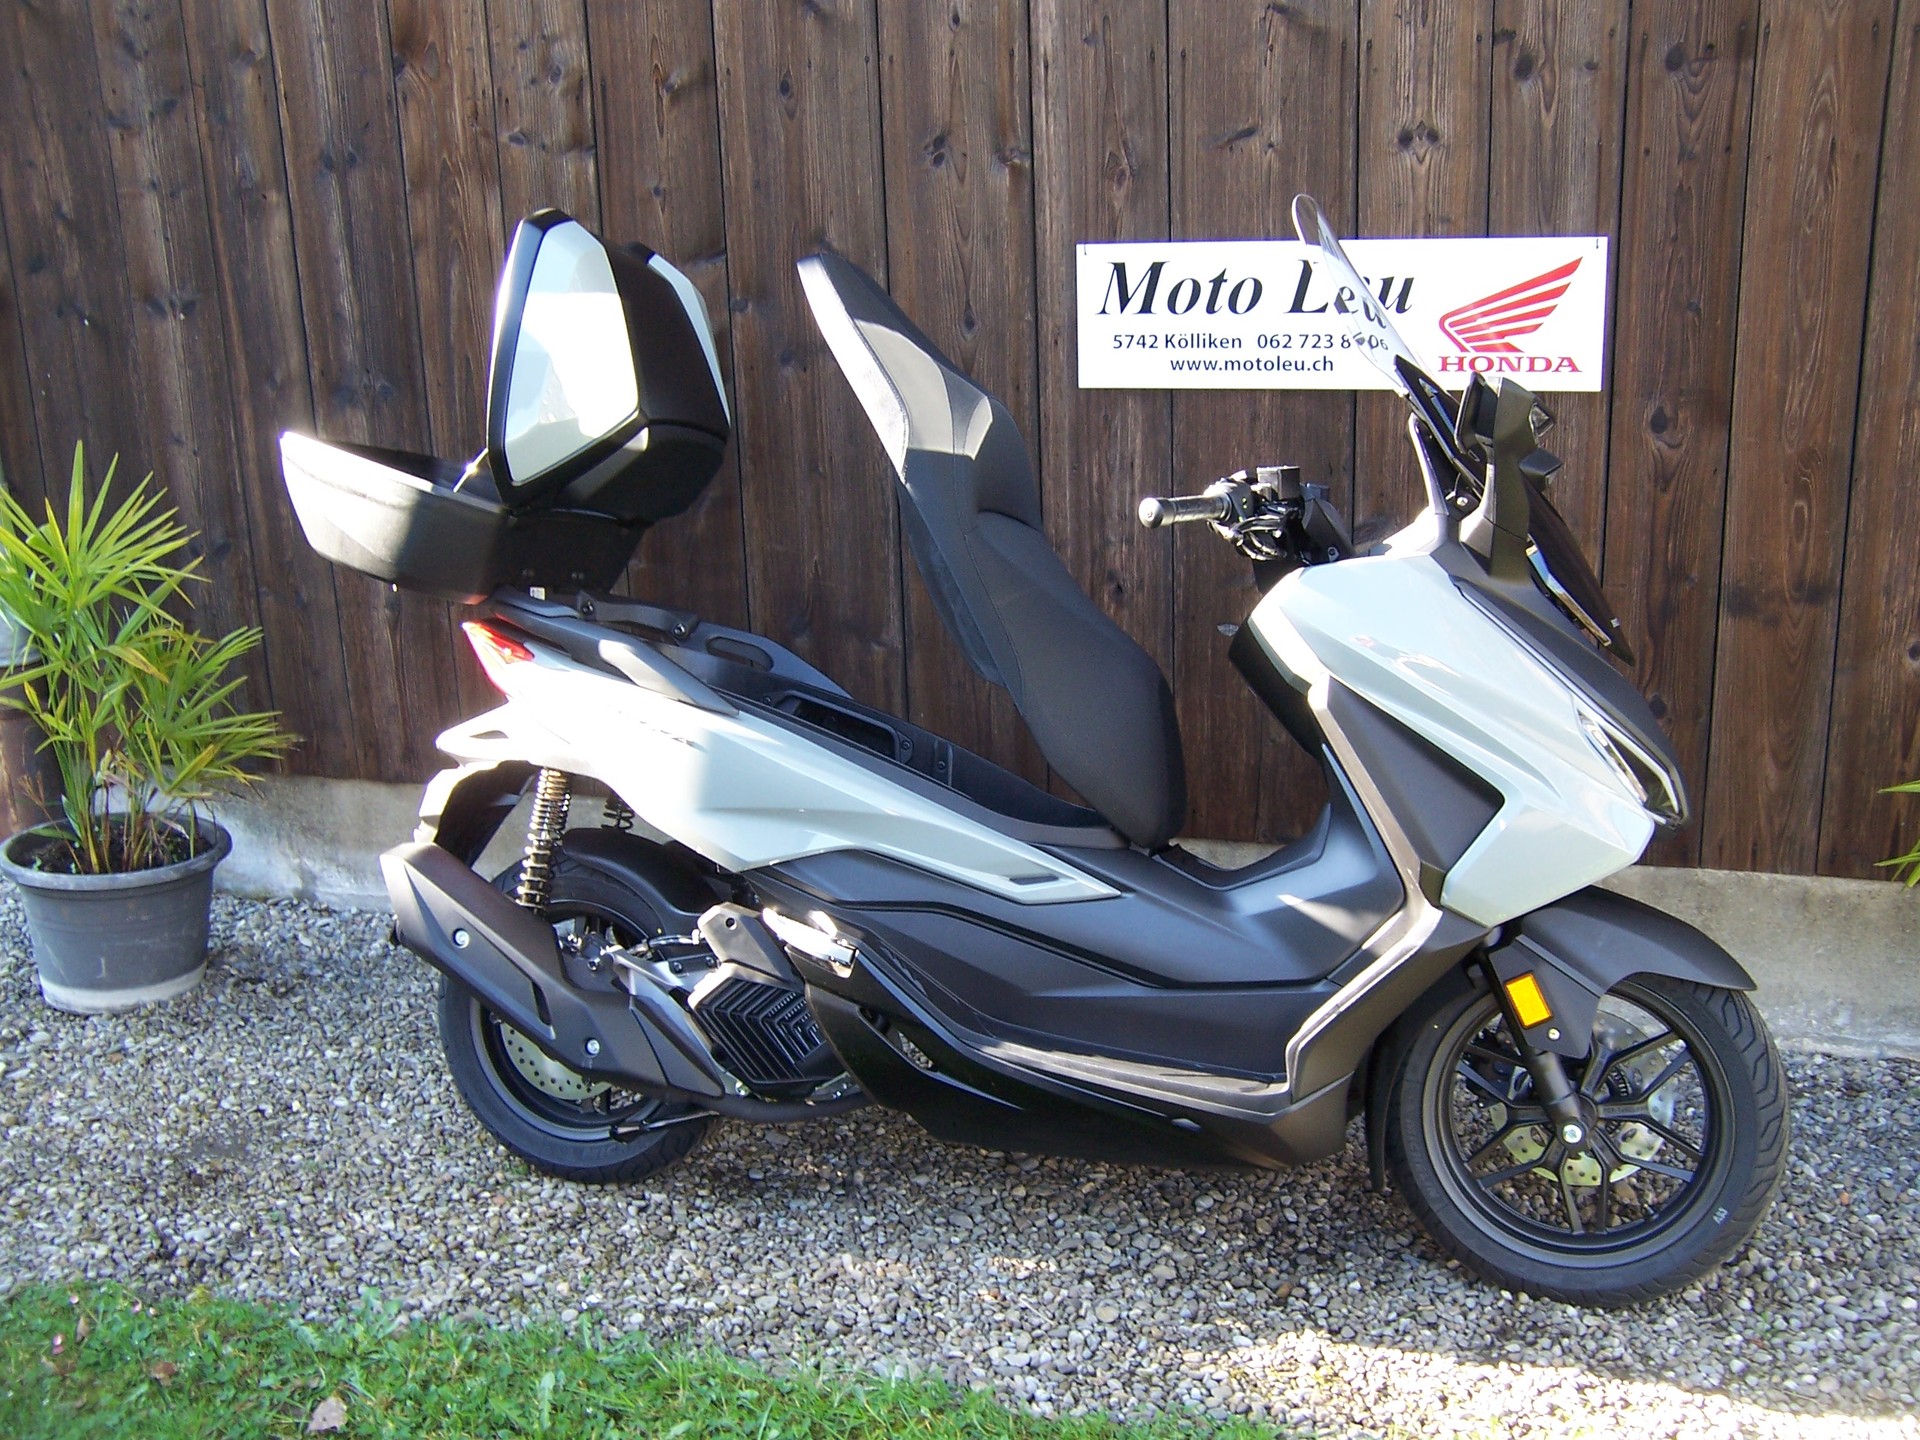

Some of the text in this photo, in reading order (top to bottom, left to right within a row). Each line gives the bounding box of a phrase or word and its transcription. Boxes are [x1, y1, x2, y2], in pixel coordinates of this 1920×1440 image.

[1097, 261, 1262, 315] Moto
[1114, 335, 1158, 349] 5742
[1165, 333, 1241, 348] Kölliken
[1258, 334, 1292, 348] 062
[1299, 334, 1333, 348] 723
[1170, 356, 1333, 371] www.motoleu.ch
[1439, 356, 1582, 372] HONDA
